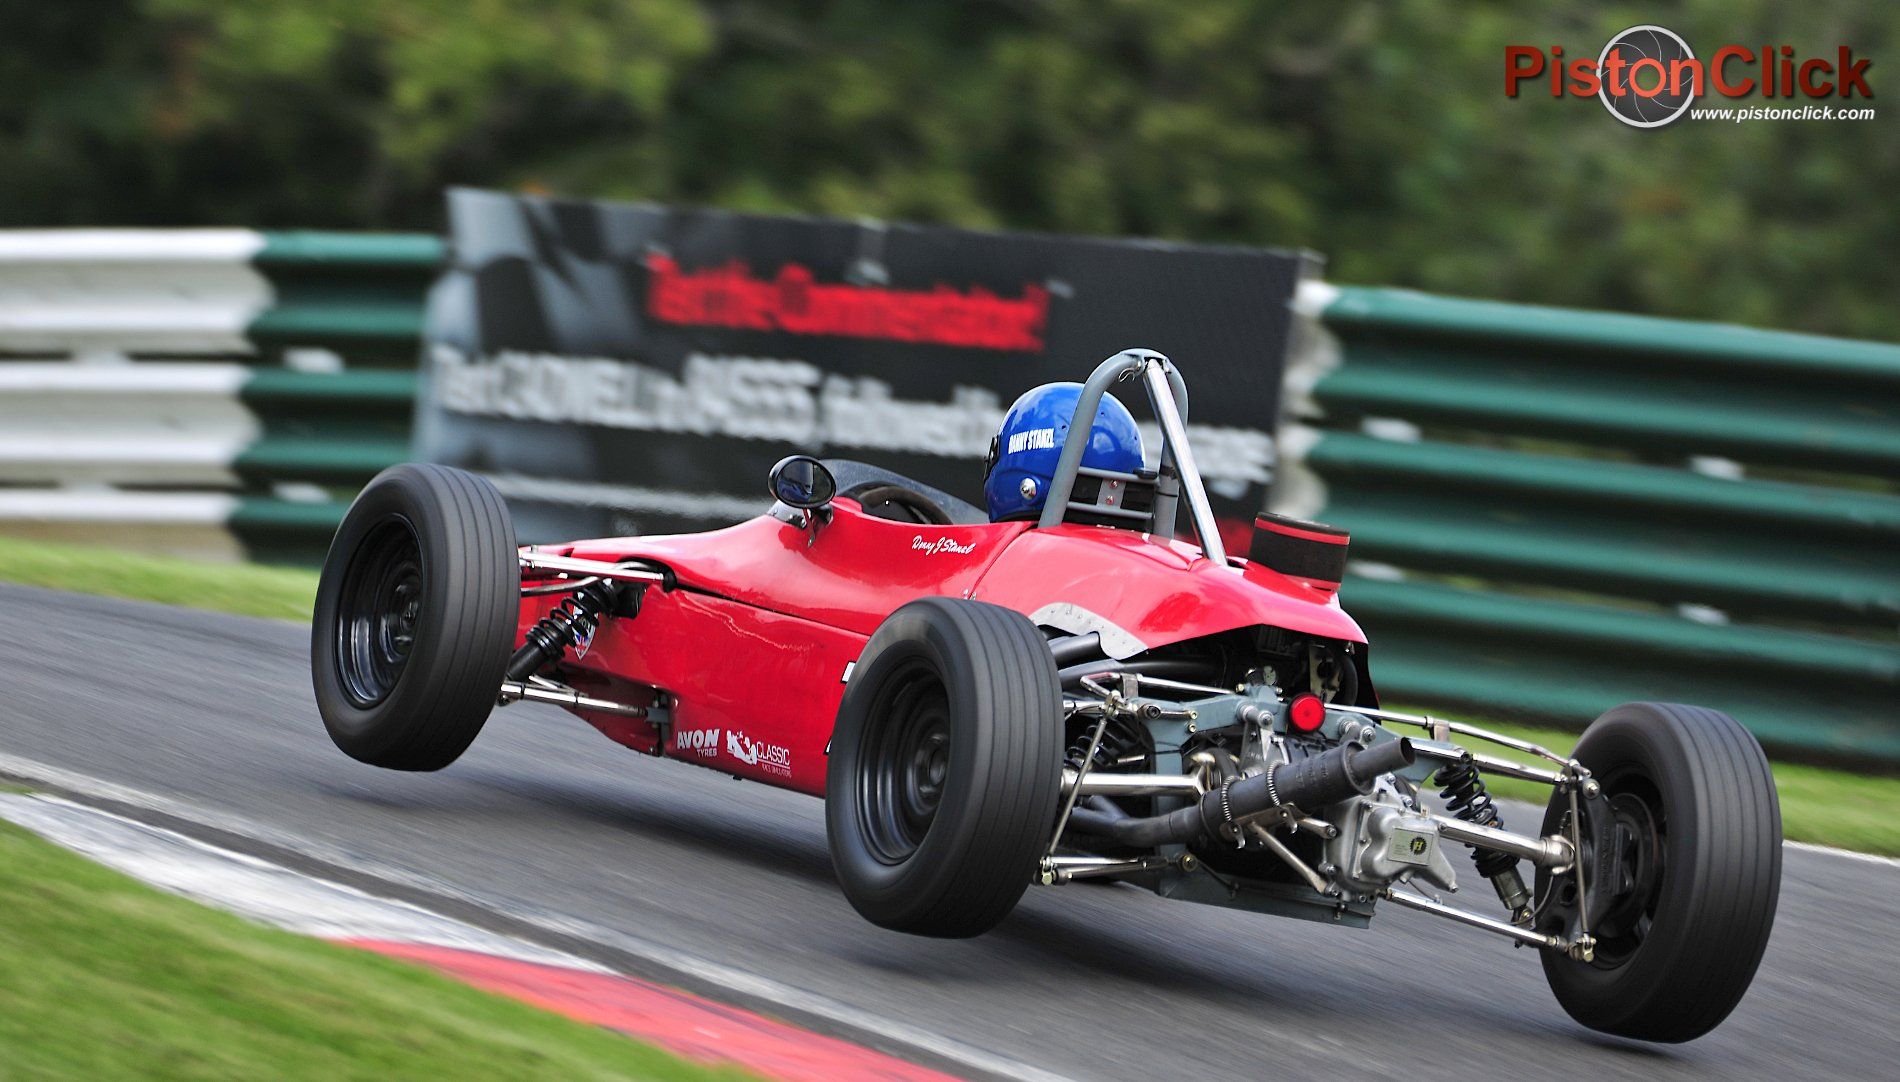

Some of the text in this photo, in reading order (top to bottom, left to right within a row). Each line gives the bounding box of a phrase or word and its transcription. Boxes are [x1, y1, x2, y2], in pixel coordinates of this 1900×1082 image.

[677, 728, 720, 750] AVON
[697, 747, 717, 758] TYRES
[756, 741, 791, 766] CLASSIC
